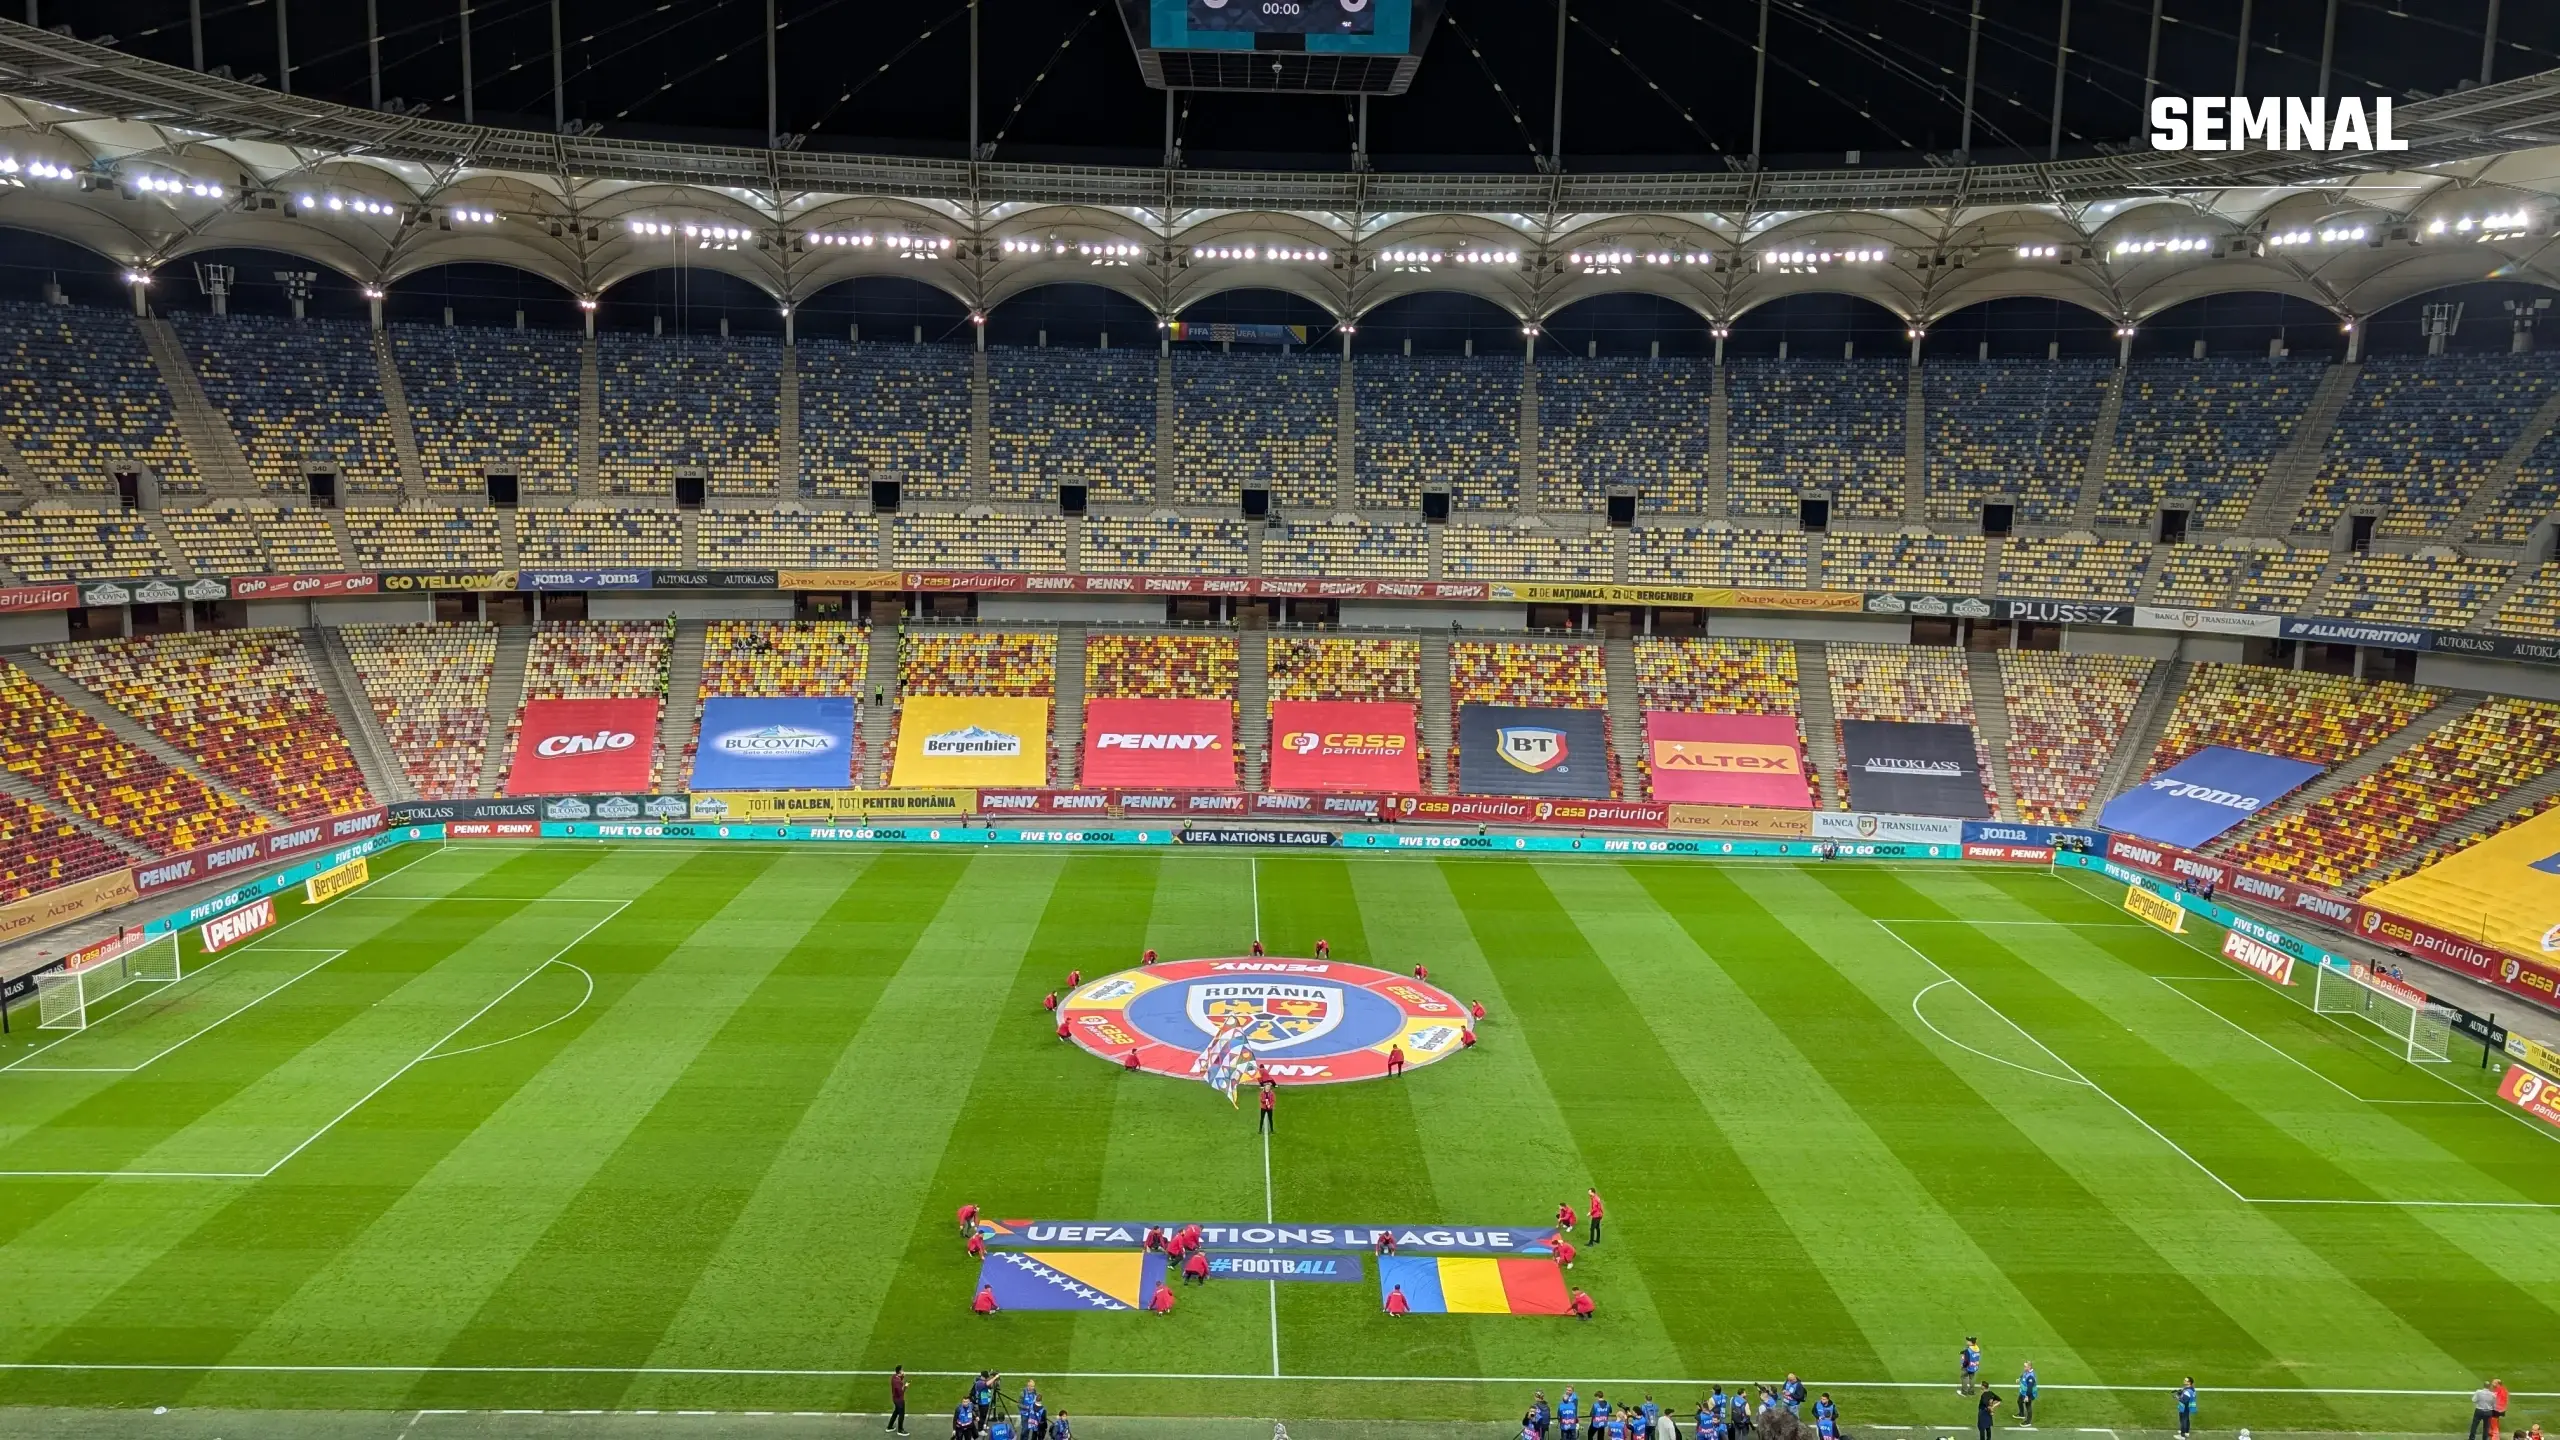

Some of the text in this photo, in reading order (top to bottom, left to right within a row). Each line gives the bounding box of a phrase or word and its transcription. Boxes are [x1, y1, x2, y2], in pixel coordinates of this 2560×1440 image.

[1263, 3, 1299, 14] 00:00
[1188, 327, 1209, 336] FIFA
[293, 577, 320, 591] Chio
[346, 576, 373, 590] Chio
[386, 575, 493, 589] GO YELLOW
[657, 575, 708, 584] AUTOKLASS
[724, 575, 774, 585] AUTOKLASS
[923, 576, 1016, 588] casa pariurilor
[238, 580, 267, 594] Chio
[1528, 589, 1538, 598] ZI
[1540, 589, 1551, 598] DE
[1612, 589, 1621, 599] ZI
[1623, 590, 1635, 599] DE
[1637, 590, 1693, 602] BERGENBIER
[2154, 613, 2180, 621] BANCA
[2201, 616, 2256, 627] TRANSILVANIA
[2307, 623, 2421, 645] ALLNUTRITION
[2436, 637, 2495, 653] AUTOKLASS
[536, 731, 636, 757] Chio
[725, 738, 828, 749] BUCOVINA
[927, 739, 1017, 754] Bergenbier
[1324, 732, 1406, 748] casa
[1511, 737, 1554, 753] BT
[1322, 746, 1404, 757] pariurilor
[1865, 758, 1960, 770] AUTOKLASS
[862, 797, 905, 808] PENTRU
[907, 794, 956, 808] ROMÂNIA
[1418, 801, 1526, 815] casa pariurilor
[395, 807, 454, 819] ATOKLASS
[474, 804, 535, 817] AUTOKLASS
[1554, 806, 1664, 821] casa pariurilor
[599, 825, 624, 836] FIVE
[626, 825, 642, 836] TO
[1822, 818, 1949, 833] BANCA BT TRANSILVANIA
[811, 828, 836, 838] FIVE
[838, 829, 854, 838] TO
[1020, 832, 1045, 841] FIVE
[1047, 832, 1063, 841] TO
[1186, 832, 1328, 844] UEFA NATIONS LEAGUE
[1399, 837, 1423, 846] FIVE
[1425, 837, 1441, 846] TO
[1604, 841, 1630, 850] FIVE
[1632, 841, 1647, 850] TO
[2105, 863, 2120, 876] FIVE
[2120, 869, 2130, 879] TO
[314, 864, 365, 898] Bergenbier
[190, 907, 209, 921] FIVE
[211, 901, 223, 912] TO
[2128, 888, 2177, 926] Bergenbier
[2233, 917, 2252, 932] FIVE
[2253, 924, 2265, 938] TO
[2381, 921, 2491, 968] casa pariurilor
[81, 949, 100, 962] casa
[2520, 970, 2554, 993] casa
[2380, 980, 2423, 1003] pariurilor
[1097, 1024, 1136, 1045] casa
[2468, 1020, 2504, 1043] AUTOKASS
[1027, 1225, 1134, 1243] UEFA
[1143, 1226, 1334, 1245] NTIONS
[1209, 1257, 1337, 1275] #FOOTBALL
